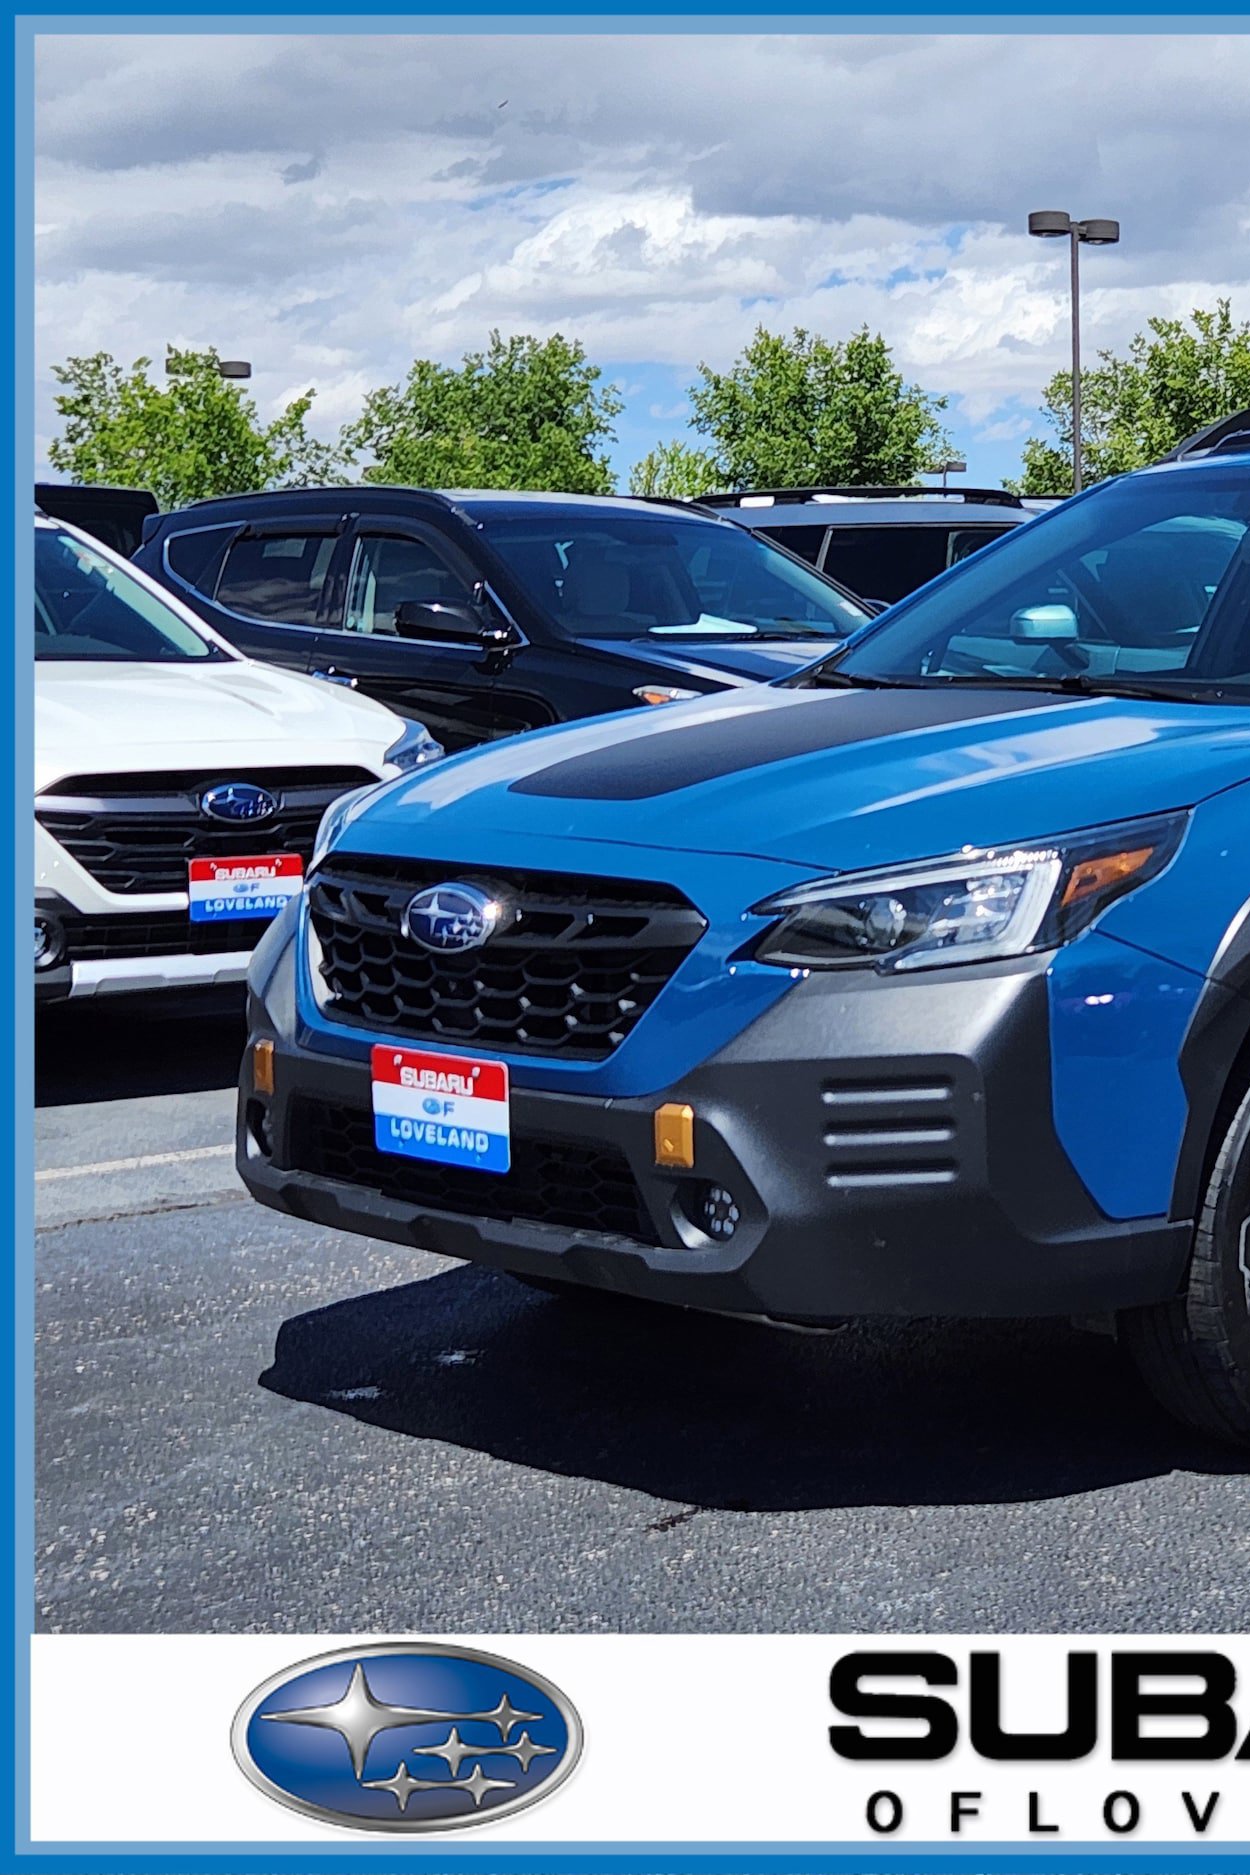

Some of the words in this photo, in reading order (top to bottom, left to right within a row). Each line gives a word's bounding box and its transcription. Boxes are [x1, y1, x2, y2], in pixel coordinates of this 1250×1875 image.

[215, 866, 277, 881] SUBARU
[205, 896, 287, 912] LOVELAND
[400, 1066, 474, 1096] SUBARU
[390, 1117, 489, 1153] LOVELAND
